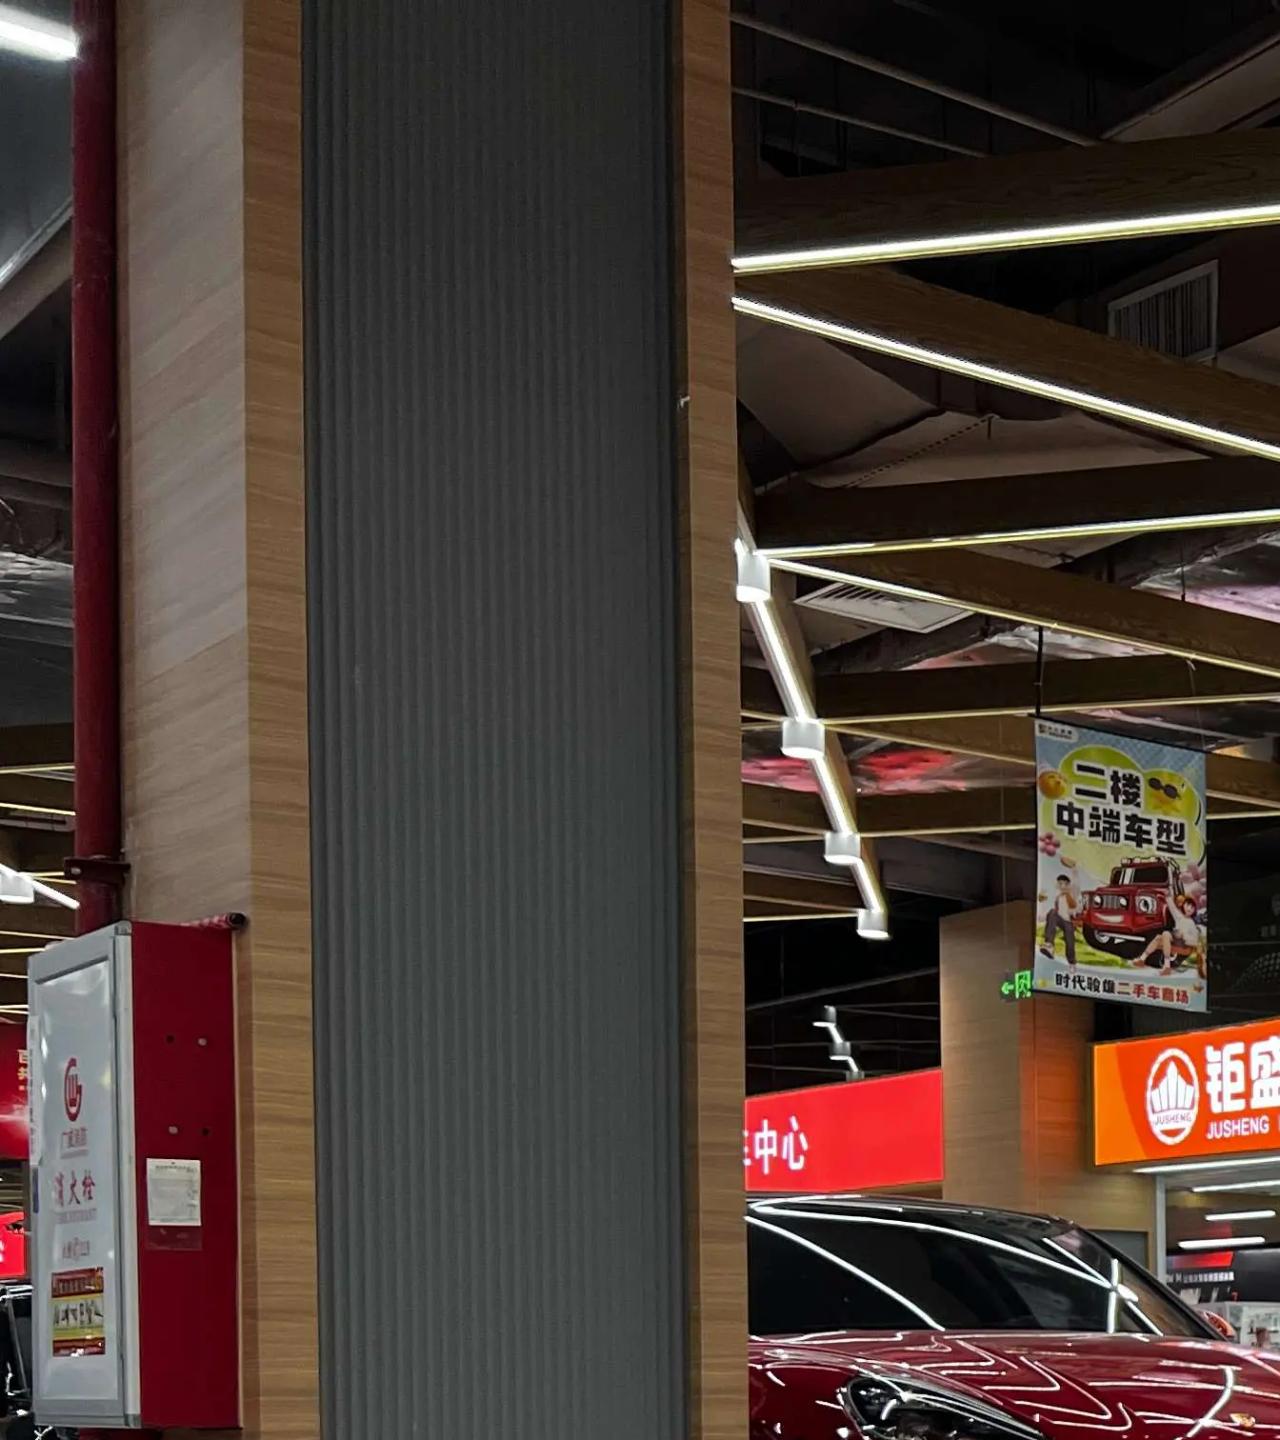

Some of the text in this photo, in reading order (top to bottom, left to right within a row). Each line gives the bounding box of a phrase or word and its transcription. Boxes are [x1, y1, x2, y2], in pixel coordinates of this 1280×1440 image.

[1074, 762, 1142, 808] 二楼
[1056, 801, 1187, 856] 中端车型
[743, 1115, 809, 1176] 中心
[1206, 1115, 1270, 1140] JUSHENG
